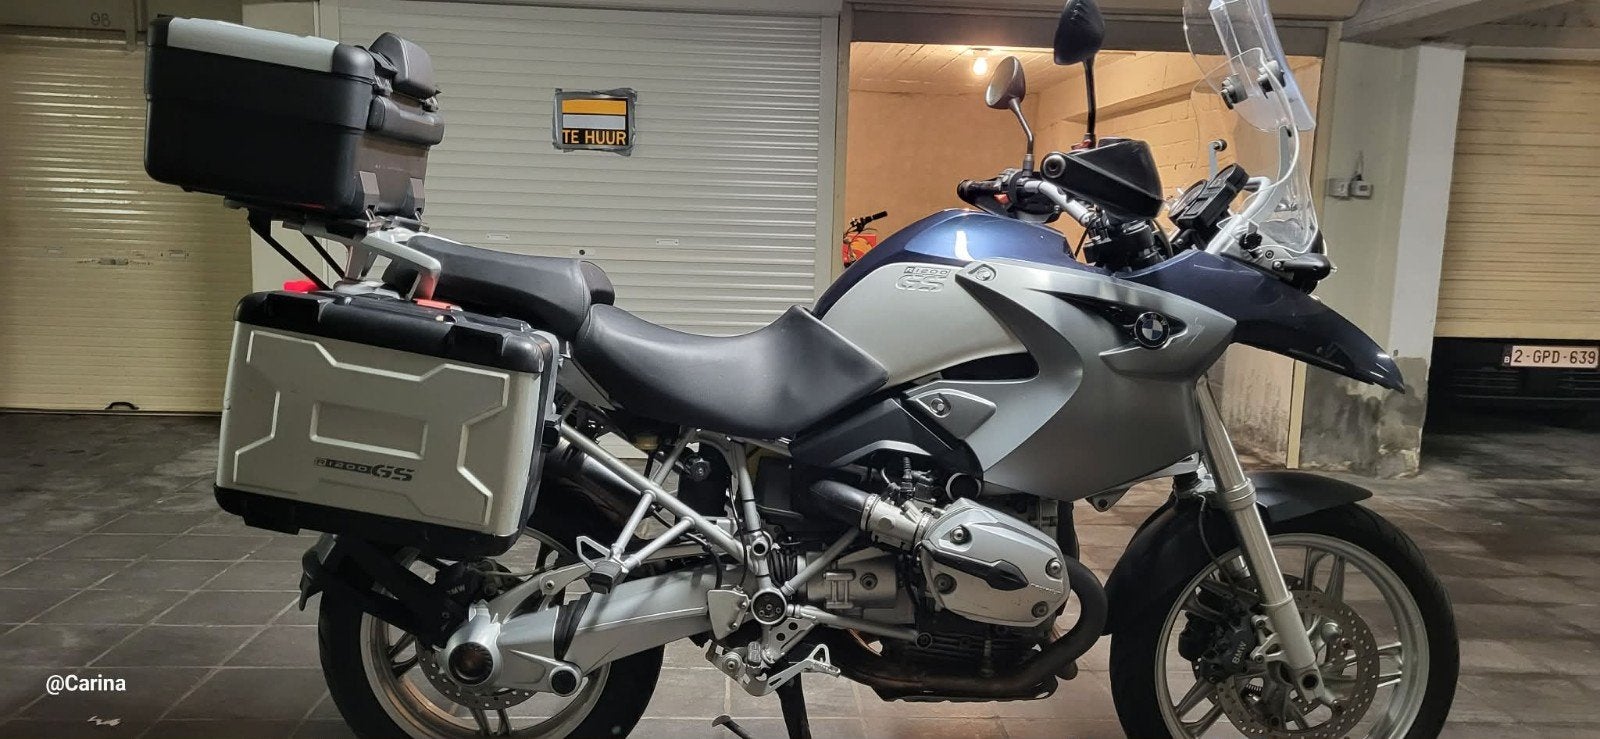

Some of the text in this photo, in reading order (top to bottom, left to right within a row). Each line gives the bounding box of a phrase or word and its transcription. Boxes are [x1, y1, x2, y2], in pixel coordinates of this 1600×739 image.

[90, 12, 111, 27] 98
[562, 130, 627, 145] TE HUUR
[904, 265, 951, 278] R1200
[895, 275, 944, 293] GS
[1514, 349, 1596, 365] 2-GPD-639
[1232, 641, 1246, 664] BMW
